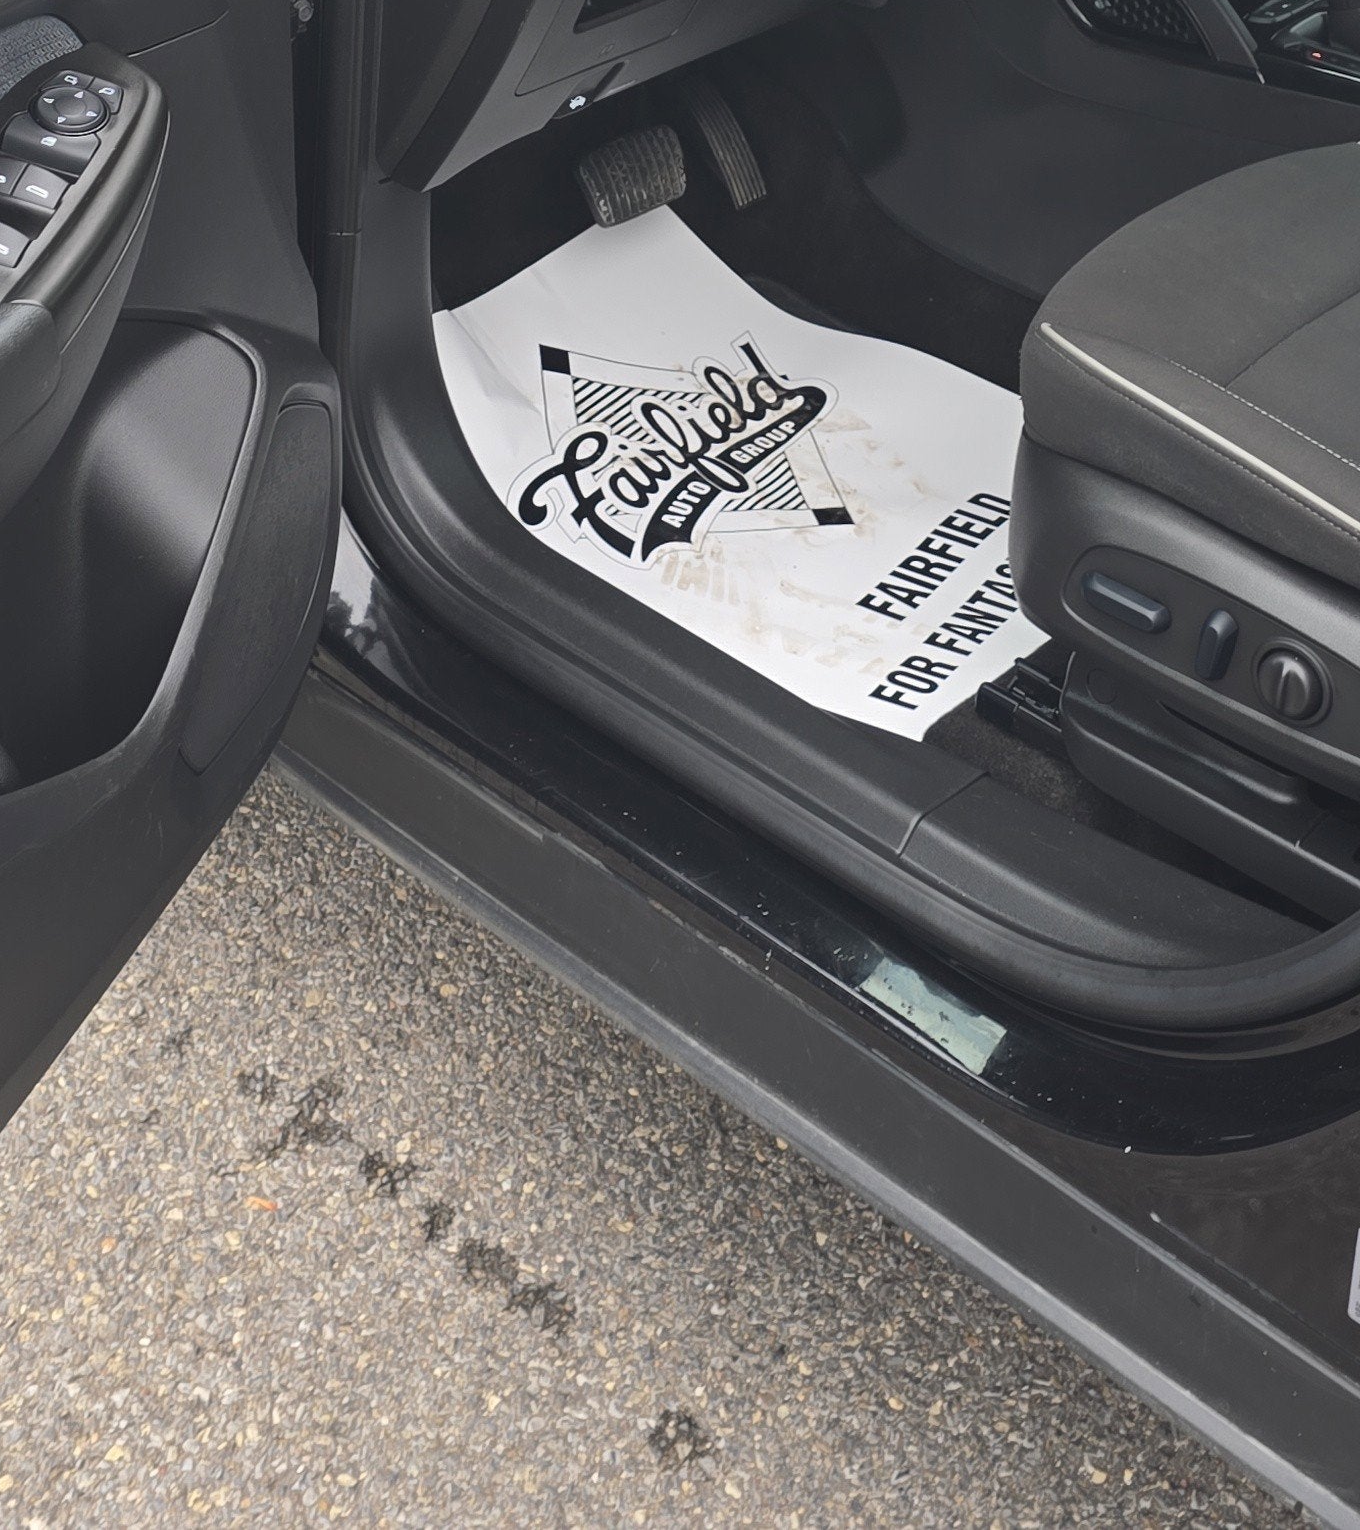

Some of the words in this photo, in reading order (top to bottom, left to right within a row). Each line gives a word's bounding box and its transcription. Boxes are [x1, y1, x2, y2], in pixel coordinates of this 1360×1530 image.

[518, 342, 827, 559] Fairfield
[660, 480, 712, 528] AUTO
[729, 420, 797, 463] GROUP
[855, 493, 1011, 621] FAIRFIELD
[868, 655, 959, 710] FOR
